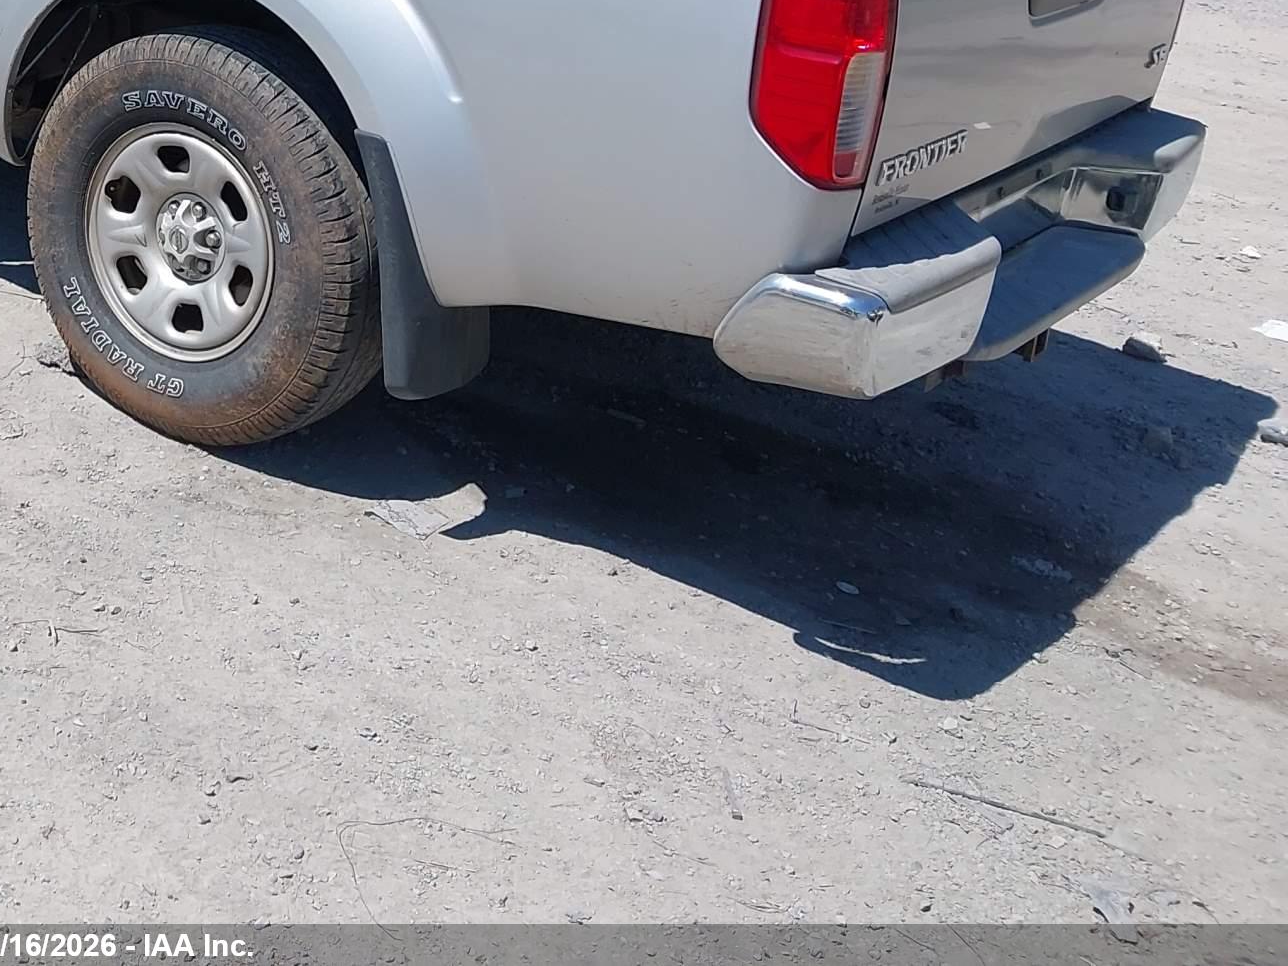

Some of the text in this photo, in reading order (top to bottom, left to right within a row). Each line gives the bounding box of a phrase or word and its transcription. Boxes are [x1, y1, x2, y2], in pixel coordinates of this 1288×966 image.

[122, 90, 247, 151] SAVERO
[875, 129, 968, 186] FRONTIER
[63, 276, 184, 398] GT RADIAL
